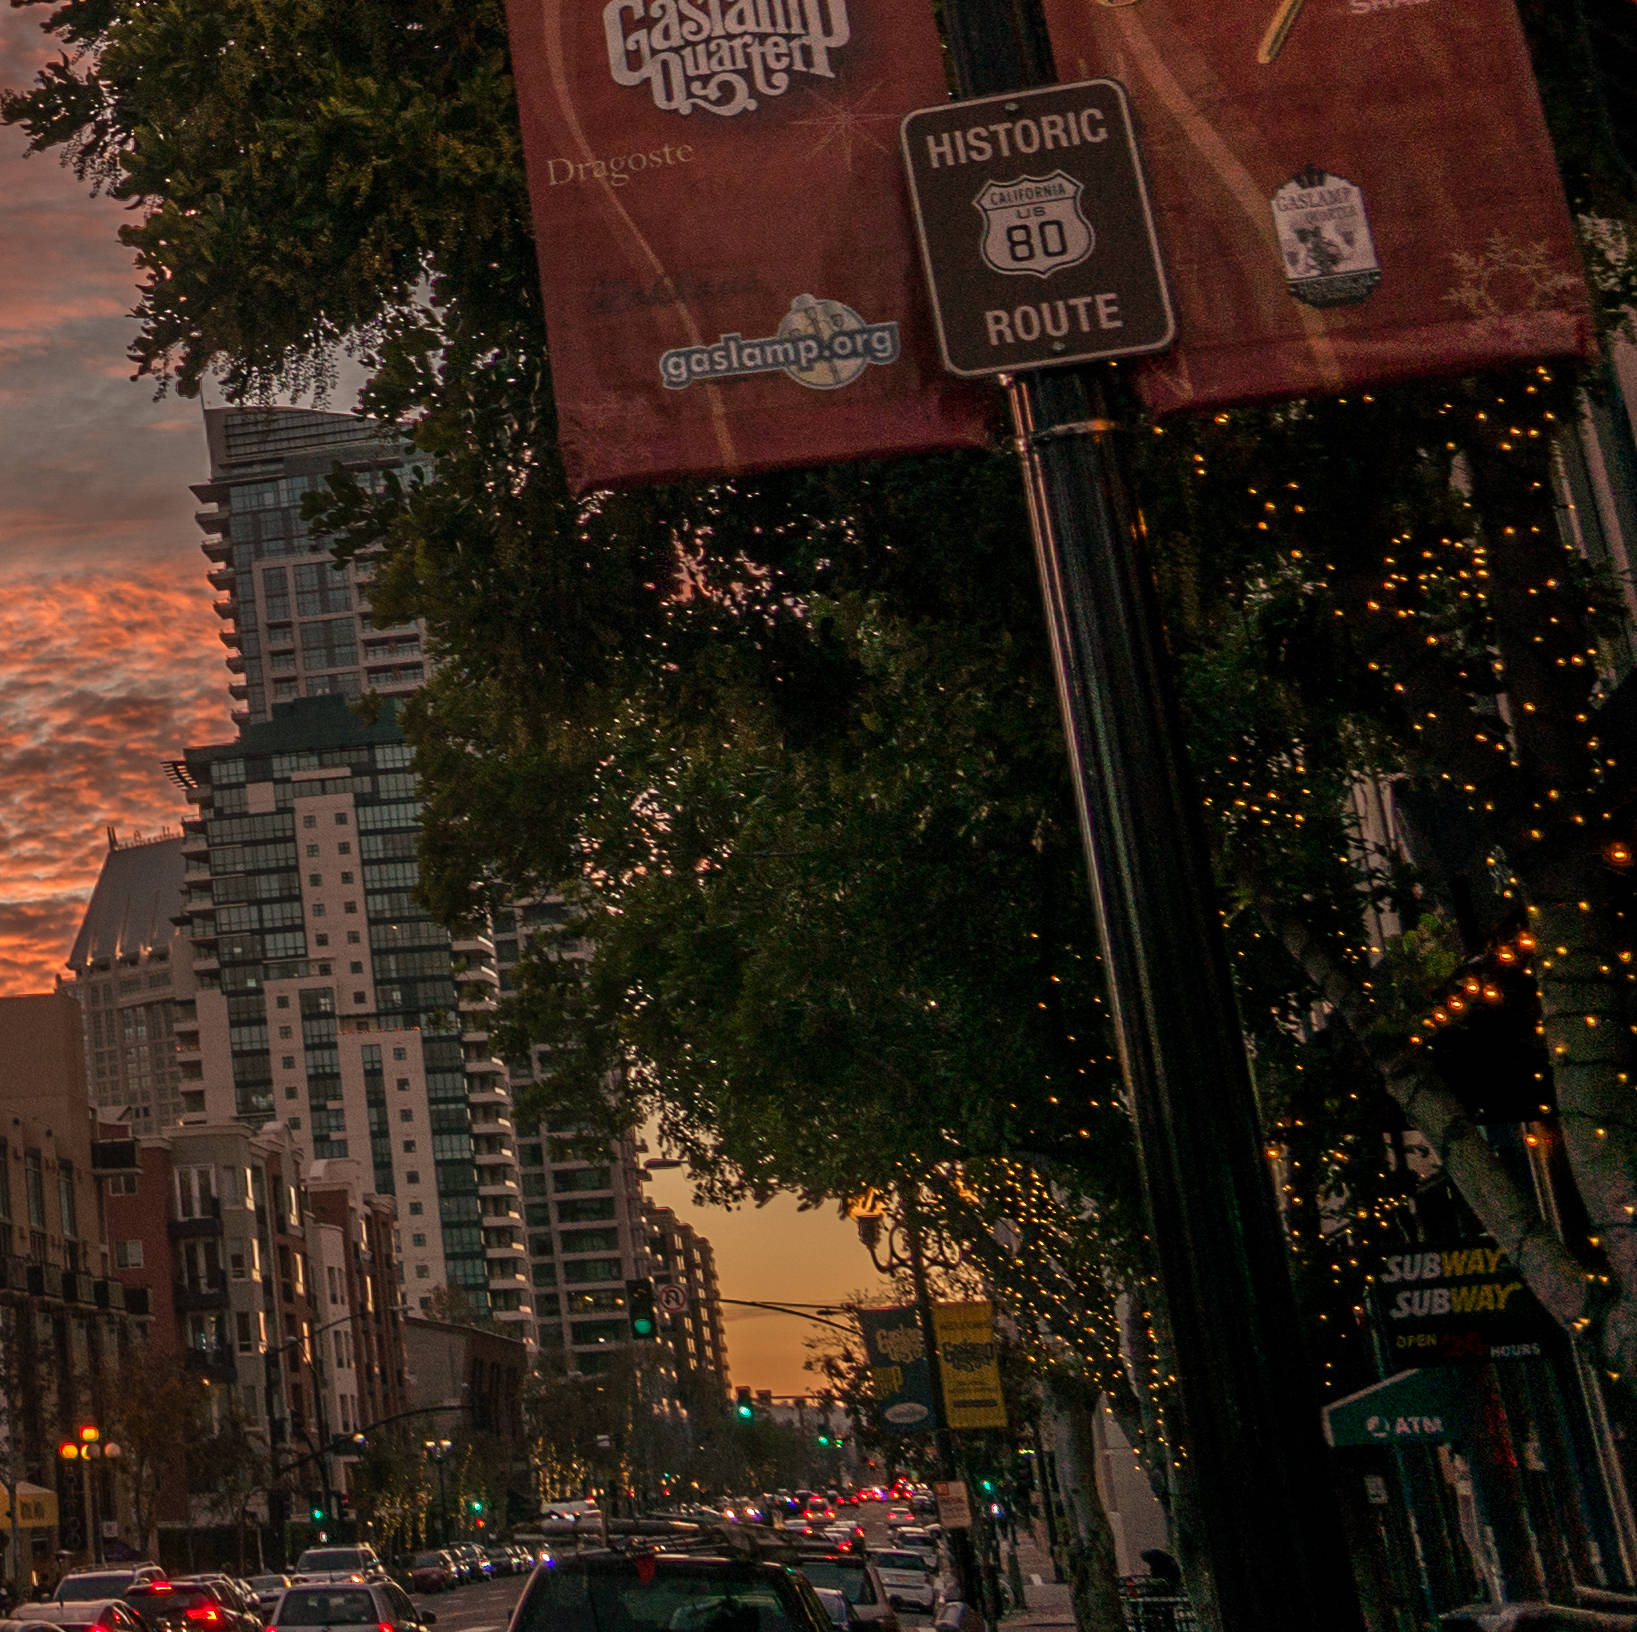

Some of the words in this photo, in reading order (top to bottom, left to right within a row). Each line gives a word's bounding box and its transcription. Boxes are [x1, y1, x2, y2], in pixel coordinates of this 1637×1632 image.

[650, 32, 837, 116] Quarter
[926, 107, 1109, 169] HISTORIC
[546, 140, 695, 186] Dragoste
[990, 182, 1067, 206] CALIFORNIA
[1016, 205, 1046, 219] US
[1006, 219, 1068, 263] 80
[984, 291, 1124, 347] ROUTE
[665, 328, 894, 382] gaslamp.org
[1379, 1247, 1506, 1283] SUBWAY
[1389, 1281, 1523, 1318] SUBWAY
[1395, 1333, 1438, 1349] OPEN
[1490, 1341, 1542, 1358] HOURS
[1394, 1415, 1445, 1435] ATM
